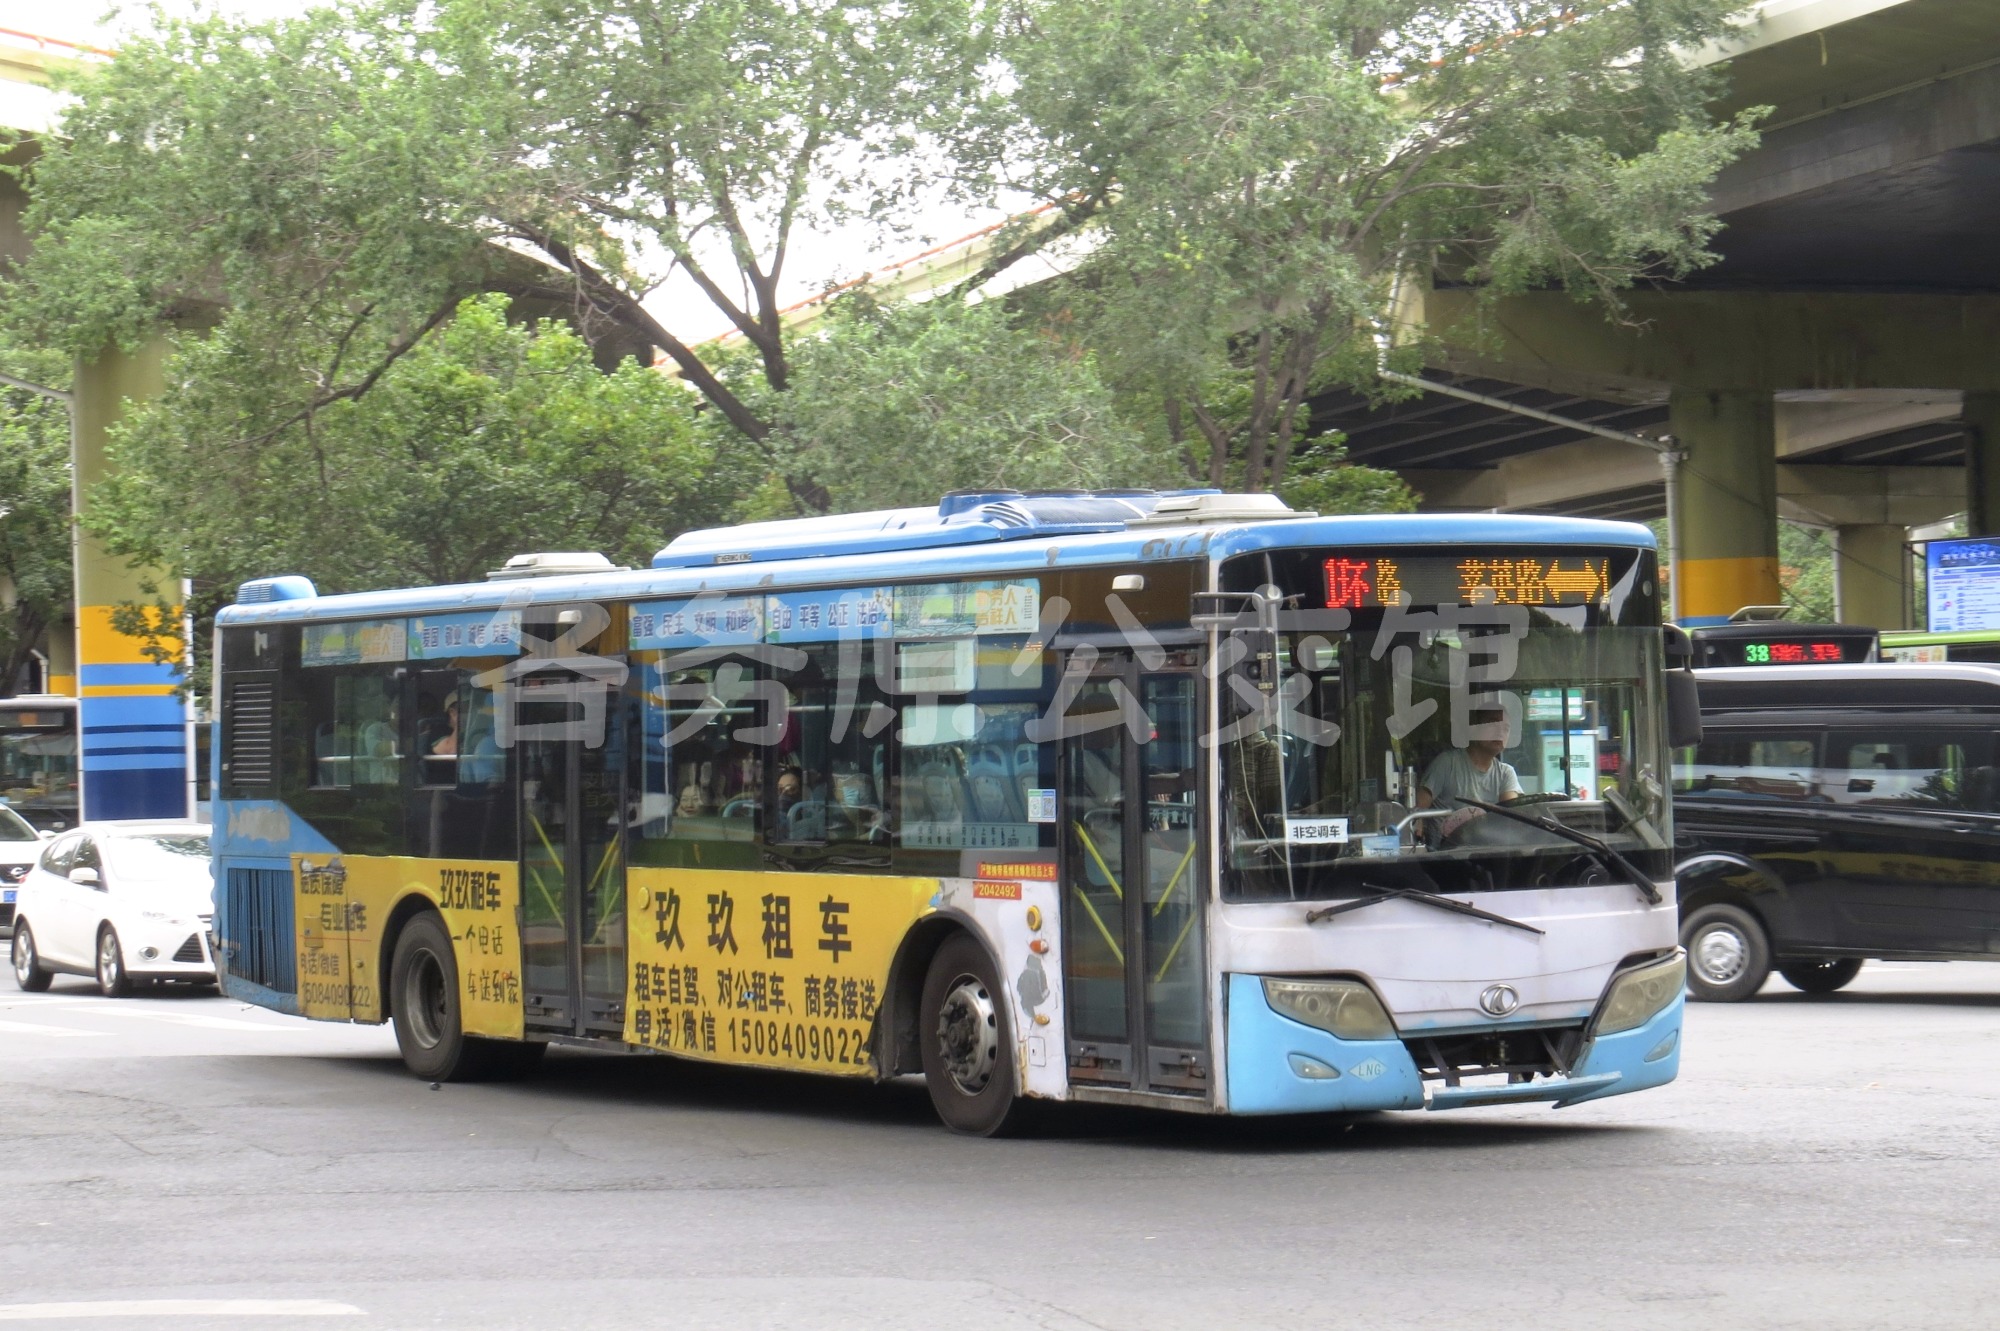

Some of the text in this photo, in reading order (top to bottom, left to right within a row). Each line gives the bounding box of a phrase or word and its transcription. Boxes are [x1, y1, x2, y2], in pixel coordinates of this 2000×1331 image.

[632, 608, 750, 638] 富强 民主 文明 和谐
[772, 601, 878, 630] 自由 平等 公正 法治
[1746, 644, 1769, 662] 38
[1292, 825, 1341, 839] 非空调车
[440, 869, 500, 912] 玖玖租车
[979, 884, 1016, 898] 2042492
[321, 902, 367, 932] 专业租车
[655, 887, 852, 964] 玖玖租车
[453, 924, 503, 956] 一个电话
[634, 1004, 870, 1065] 电话/微信 1508409022
[1357, 1063, 1382, 1078] LNG
